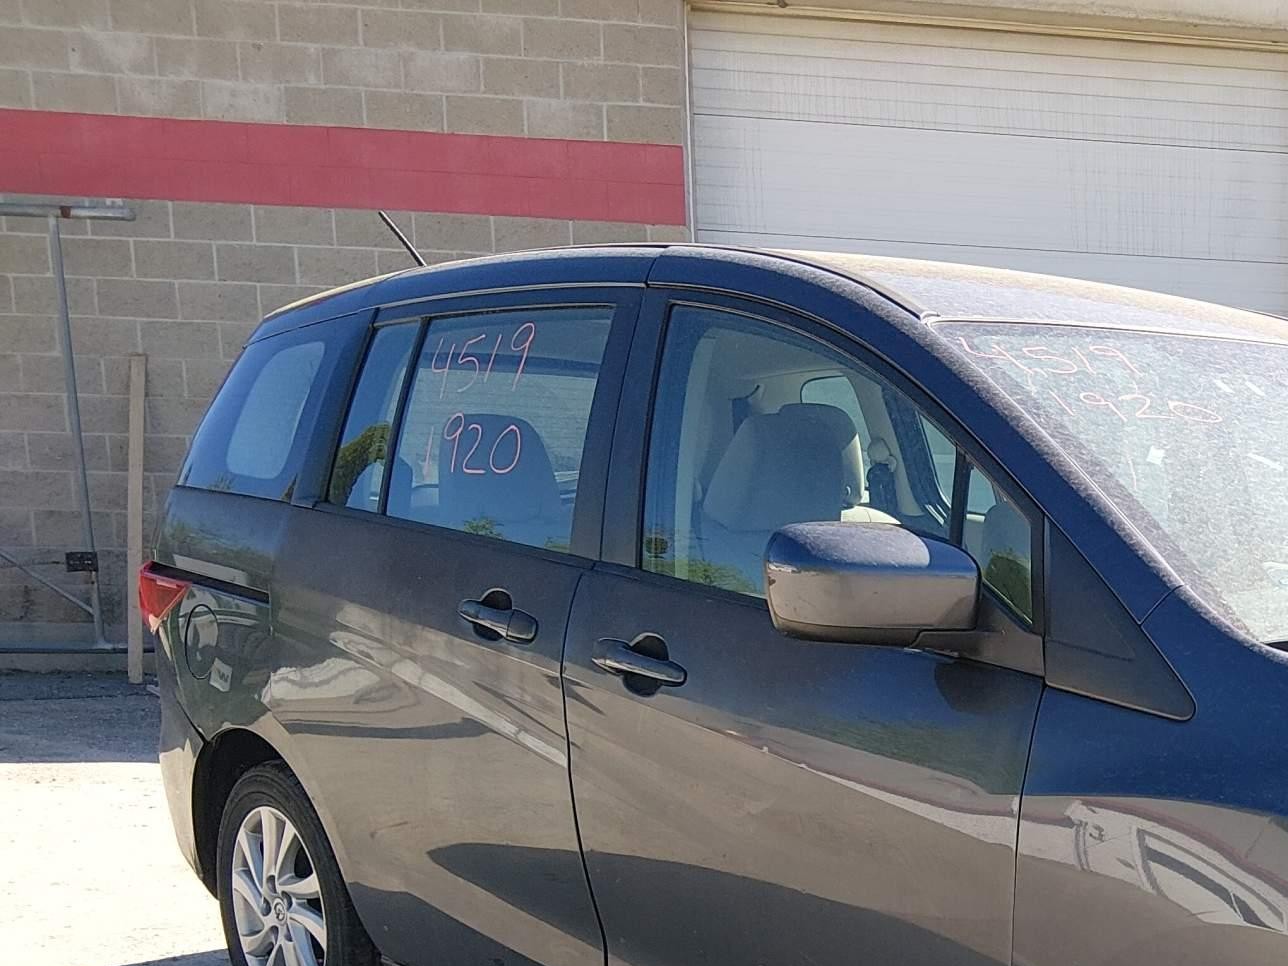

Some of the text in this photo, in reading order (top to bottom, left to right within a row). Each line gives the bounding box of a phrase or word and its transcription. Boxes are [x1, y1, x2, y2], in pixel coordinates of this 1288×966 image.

[430, 321, 537, 399] 4519
[958, 336, 1146, 376] 4519
[1049, 391, 1223, 424] 1920
[423, 411, 522, 481] 1920
